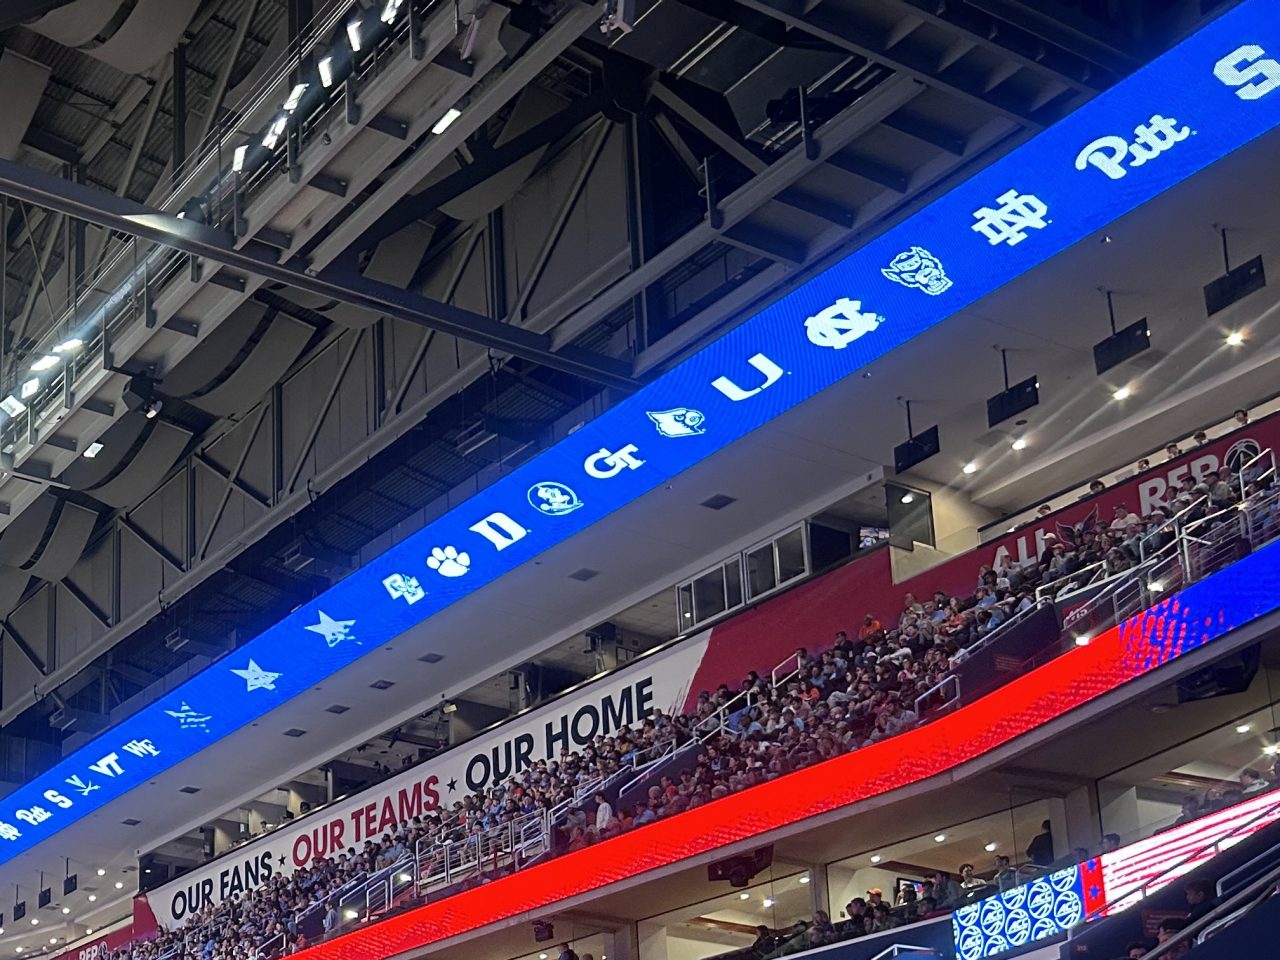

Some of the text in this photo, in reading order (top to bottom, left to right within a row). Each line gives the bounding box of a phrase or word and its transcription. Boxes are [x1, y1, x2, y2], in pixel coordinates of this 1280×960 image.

[1075, 114, 1190, 180] Pitt
[1213, 45, 1280, 100] S
[171, 677, 655, 921] OUR FANS OUR TEAMS OUR HOME
